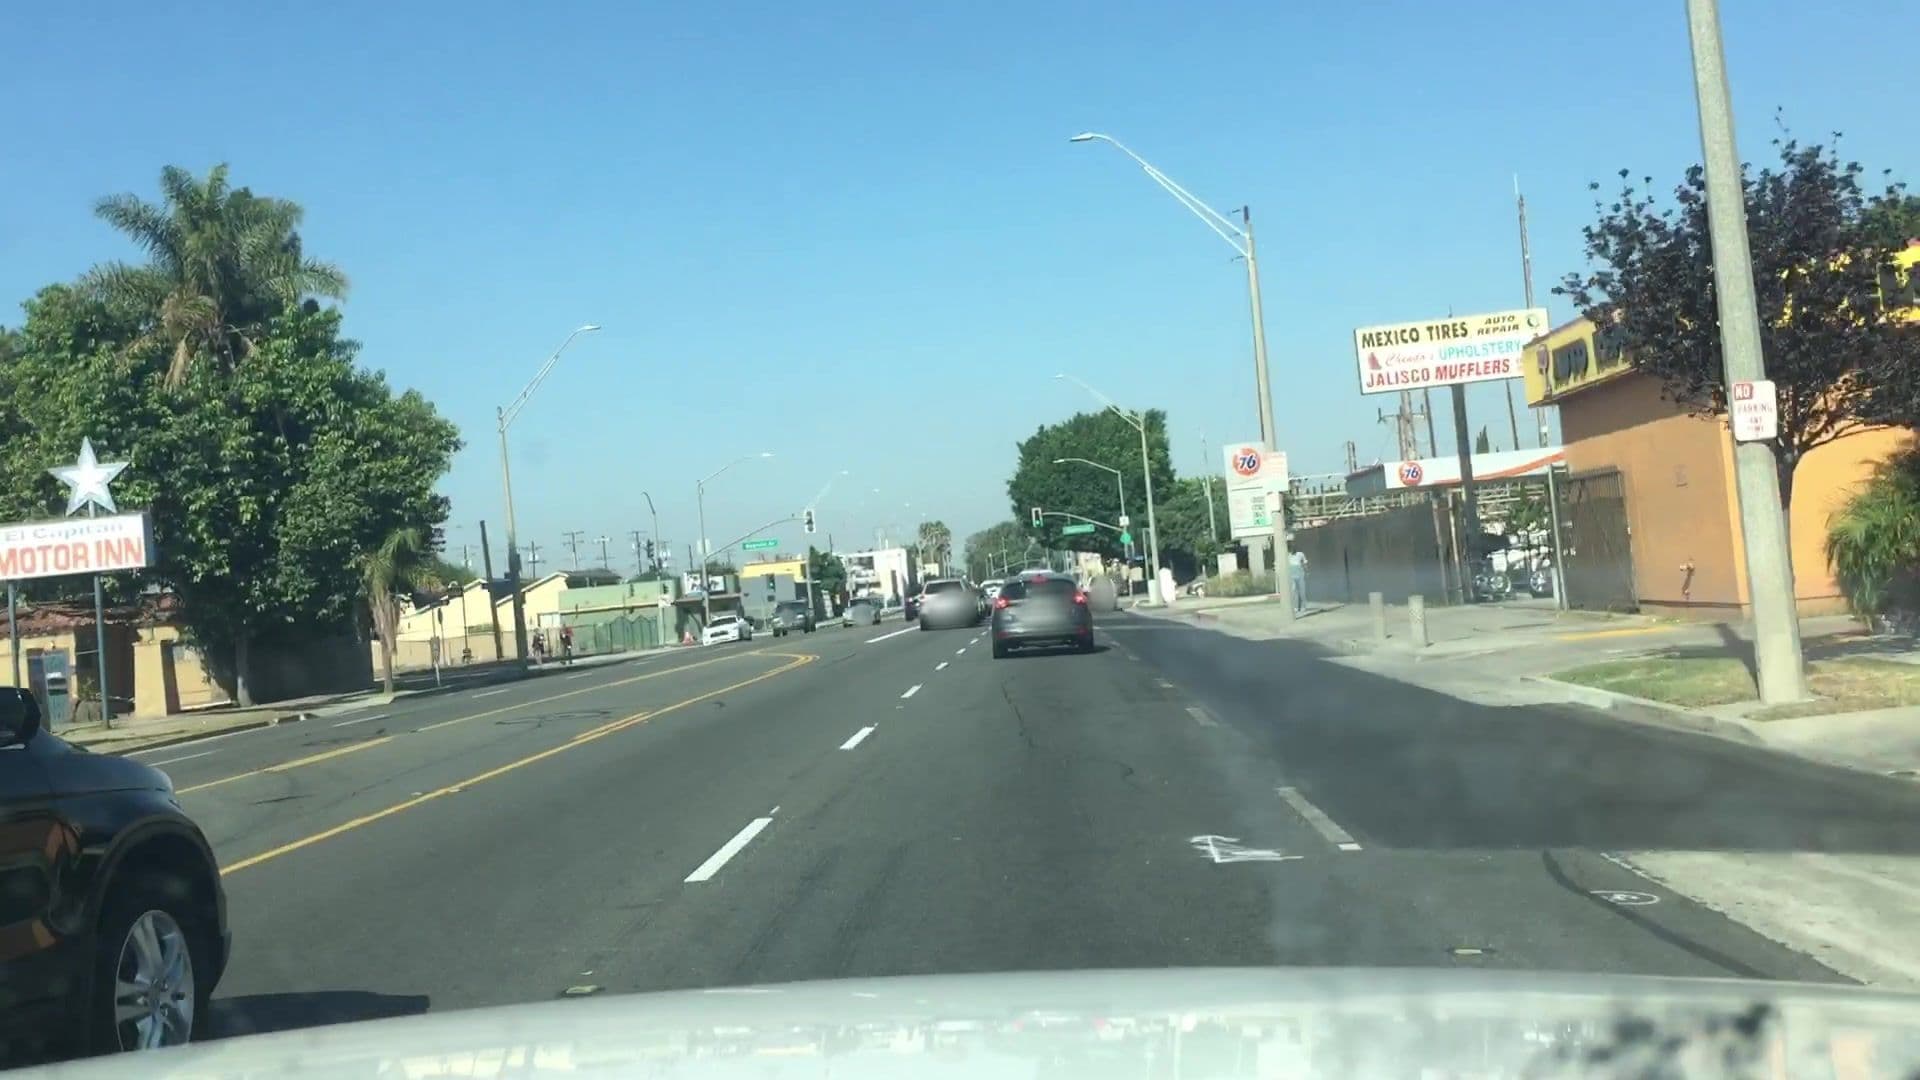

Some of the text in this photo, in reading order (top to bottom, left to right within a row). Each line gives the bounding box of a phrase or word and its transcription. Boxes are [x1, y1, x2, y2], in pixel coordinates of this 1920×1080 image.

[1484, 315, 1515, 325] AUTO
[1361, 321, 1468, 349] MEXICO TIRES
[1477, 324, 1520, 336] REPAIR
[1438, 340, 1521, 361] UPHOLSTERY
[1366, 367, 1430, 388] JALISCO
[1435, 358, 1510, 381] MUFFLERS
[1735, 384, 1752, 399] NO
[1240, 454, 1257, 469] 76
[1404, 466, 1420, 478] 76
[5, 521, 123, 541] El Capitan
[0, 536, 142, 576] MOTOR INN
